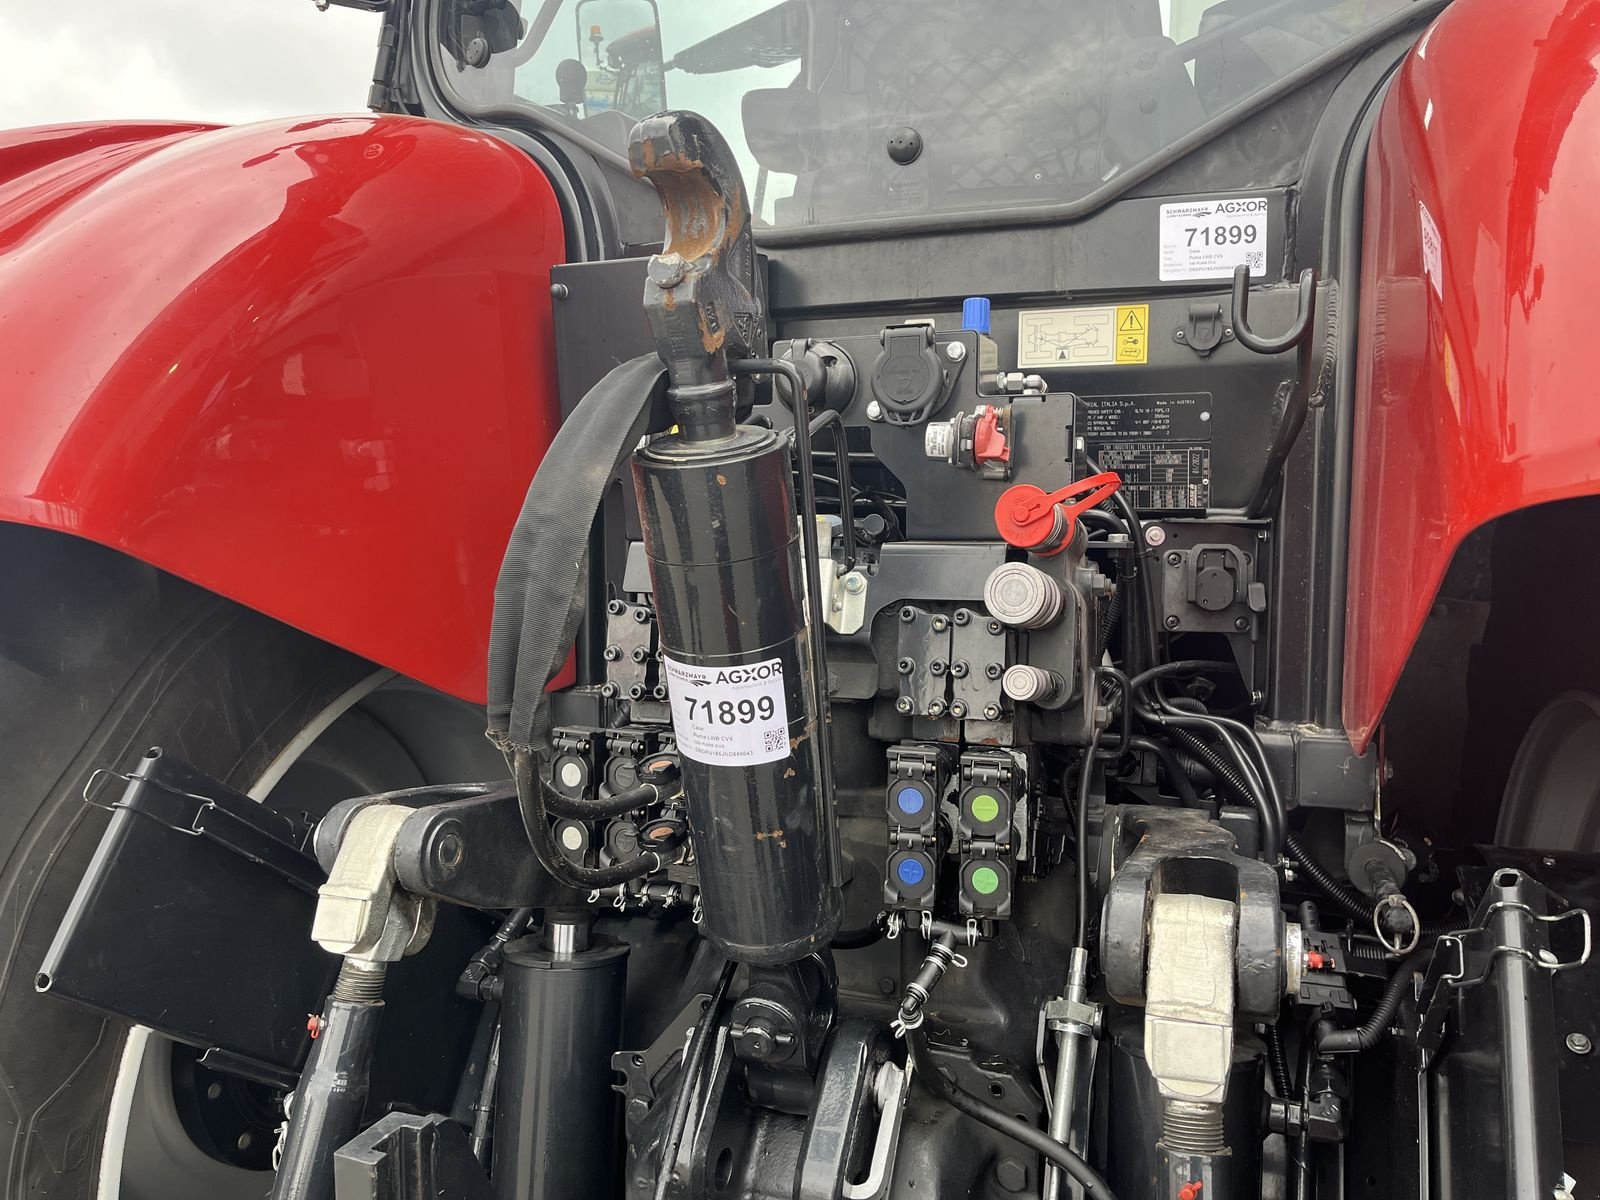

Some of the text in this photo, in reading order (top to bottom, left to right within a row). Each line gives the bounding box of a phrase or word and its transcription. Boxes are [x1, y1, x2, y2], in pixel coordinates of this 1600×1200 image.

[1166, 206, 1208, 214] SCHWARZMAYR
[1215, 200, 1267, 214] AGXOR
[1184, 224, 1257, 247] 71899
[716, 662, 782, 684] AGXOR
[684, 696, 774, 725] 71899
